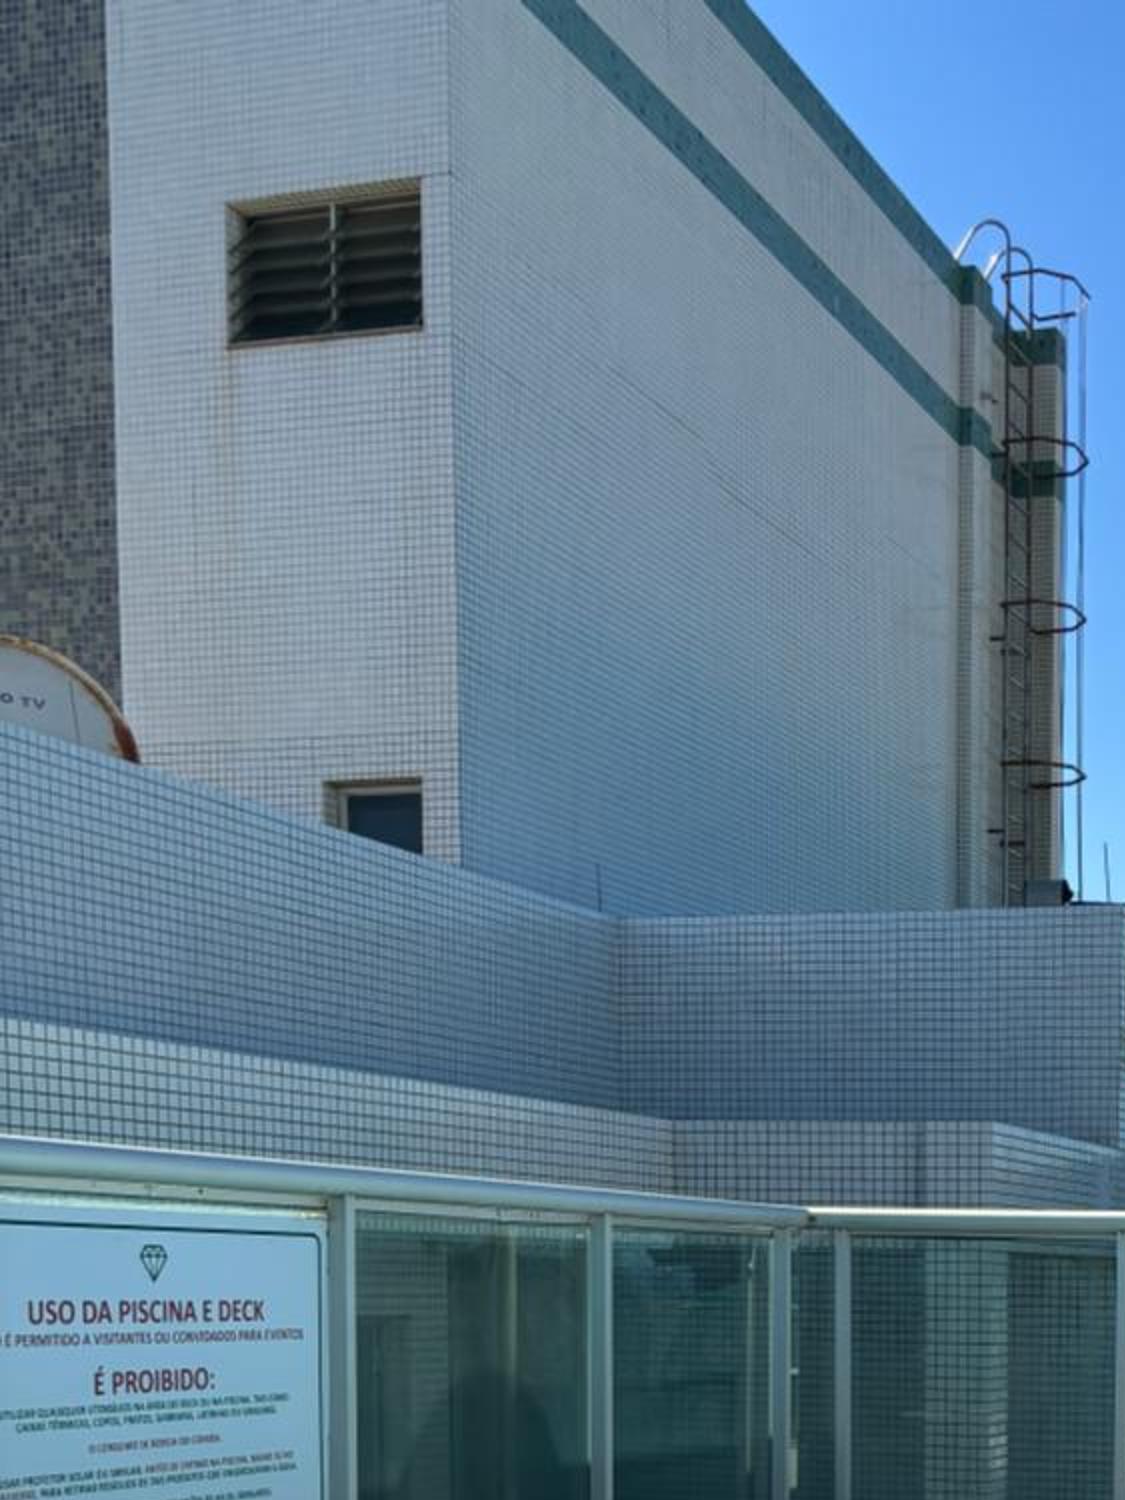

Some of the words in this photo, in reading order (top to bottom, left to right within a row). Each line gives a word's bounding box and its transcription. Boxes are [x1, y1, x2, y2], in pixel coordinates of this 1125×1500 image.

[20, 695, 46, 710] TV
[27, 1299, 76, 1326] USO
[81, 1299, 113, 1325] DA
[118, 1299, 198, 1324] PISCINA
[202, 1299, 213, 1323] E
[217, 1299, 266, 1323] DECK
[14, 1332, 81, 1347] PERMITIDO
[81, 1332, 92, 1346] A
[93, 1330, 151, 1346] VISITANTES
[154, 1330, 171, 1344] OU
[172, 1328, 237, 1344] CONVIDADOS
[238, 1327, 262, 1342] PARA
[93, 1365, 105, 1396] É
[111, 1366, 216, 1396] PROIBIDO:
